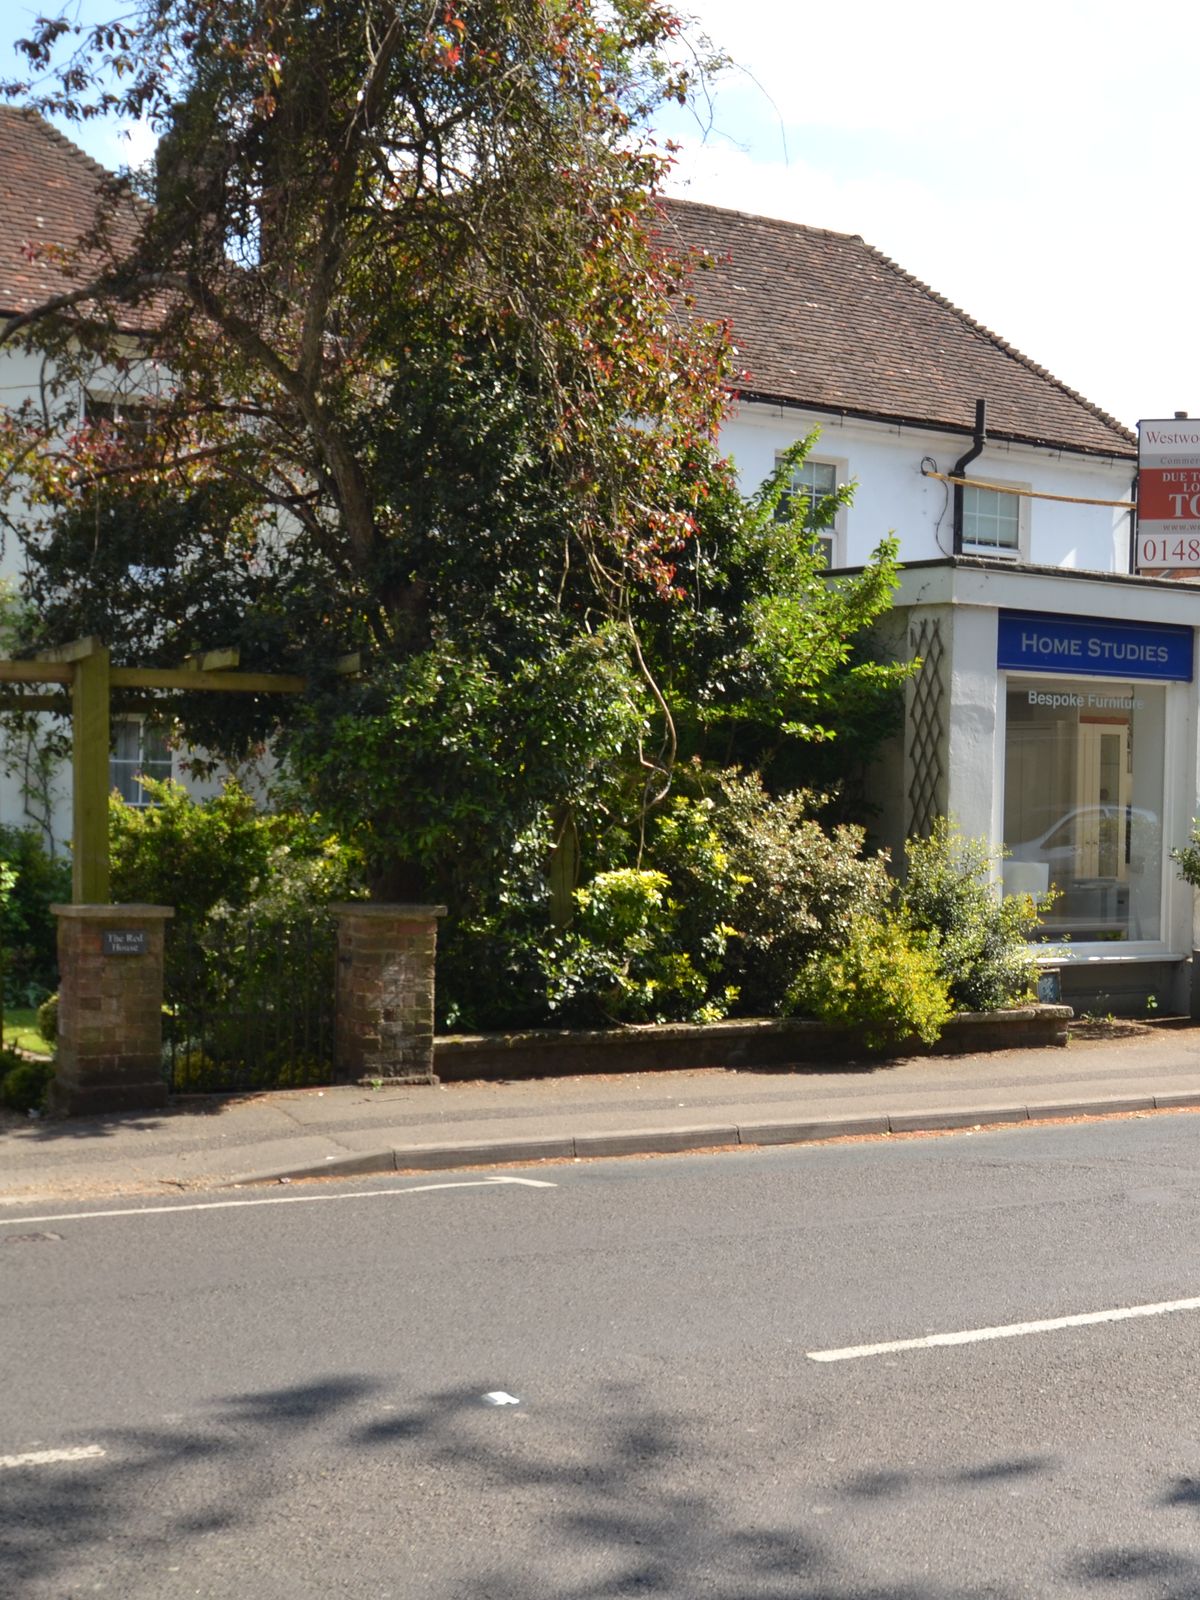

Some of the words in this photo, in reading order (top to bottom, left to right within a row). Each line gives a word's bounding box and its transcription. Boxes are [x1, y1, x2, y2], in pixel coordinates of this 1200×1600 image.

[1162, 472, 1188, 482] DUE
[1028, 690, 1084, 708] Bespoke
[1088, 693, 1144, 710] Furniture
